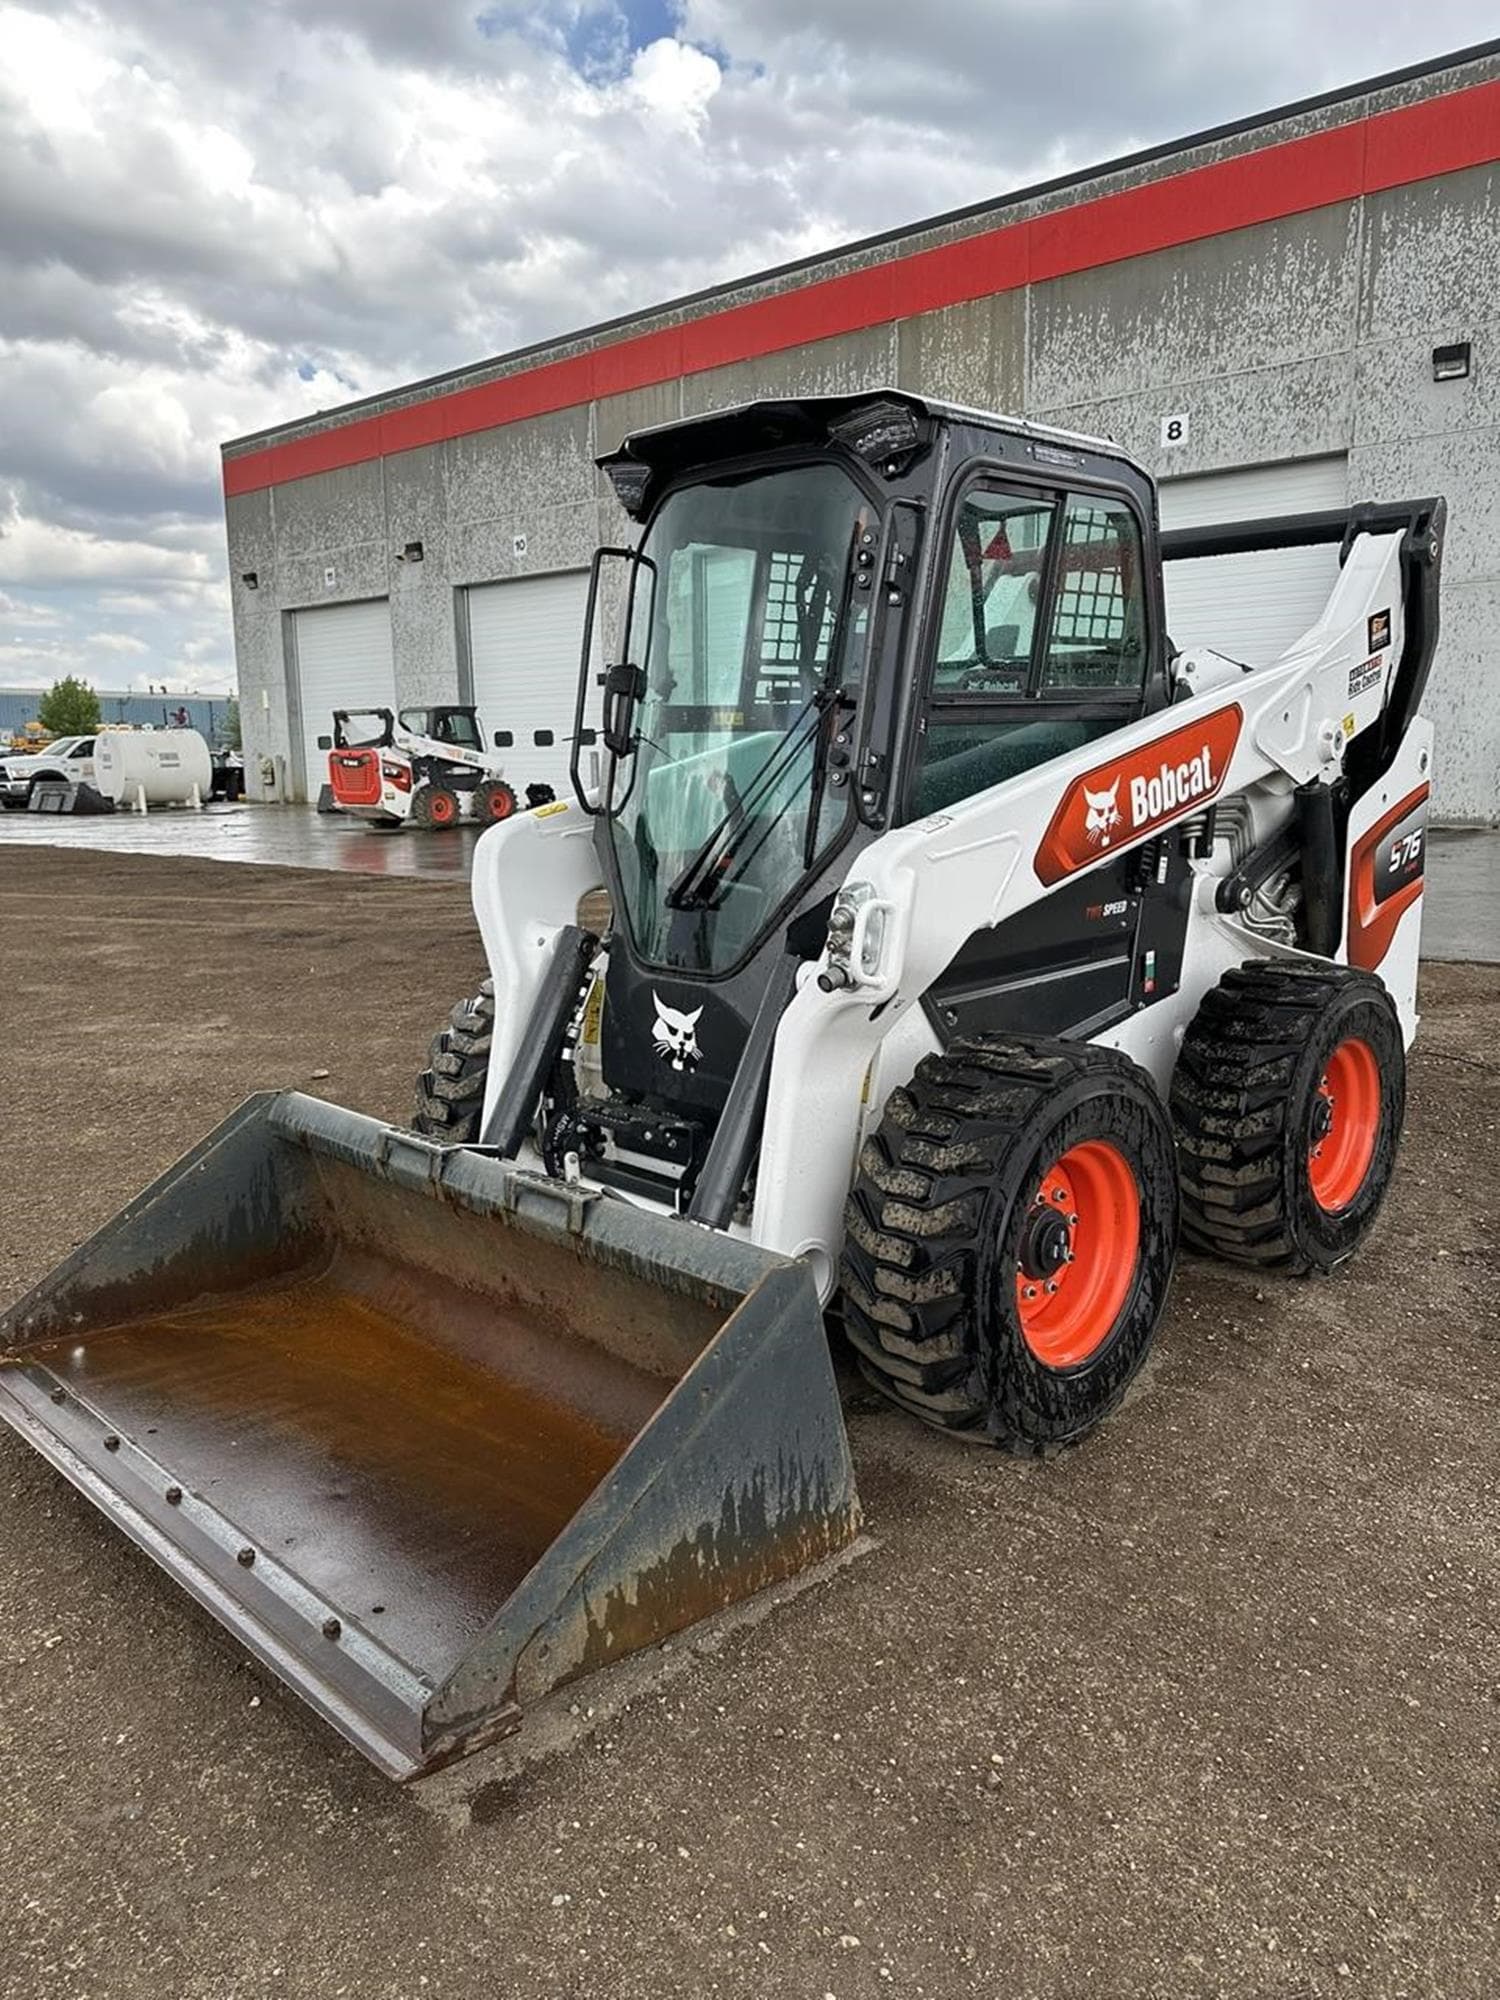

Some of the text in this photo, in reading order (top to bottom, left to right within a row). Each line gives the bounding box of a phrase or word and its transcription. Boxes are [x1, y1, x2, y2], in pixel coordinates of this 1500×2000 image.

[1167, 420, 1182, 441] 8
[515, 539, 526, 551] 10
[1130, 744, 1212, 828] Bobcat
[1103, 900, 1127, 917] SPEED
